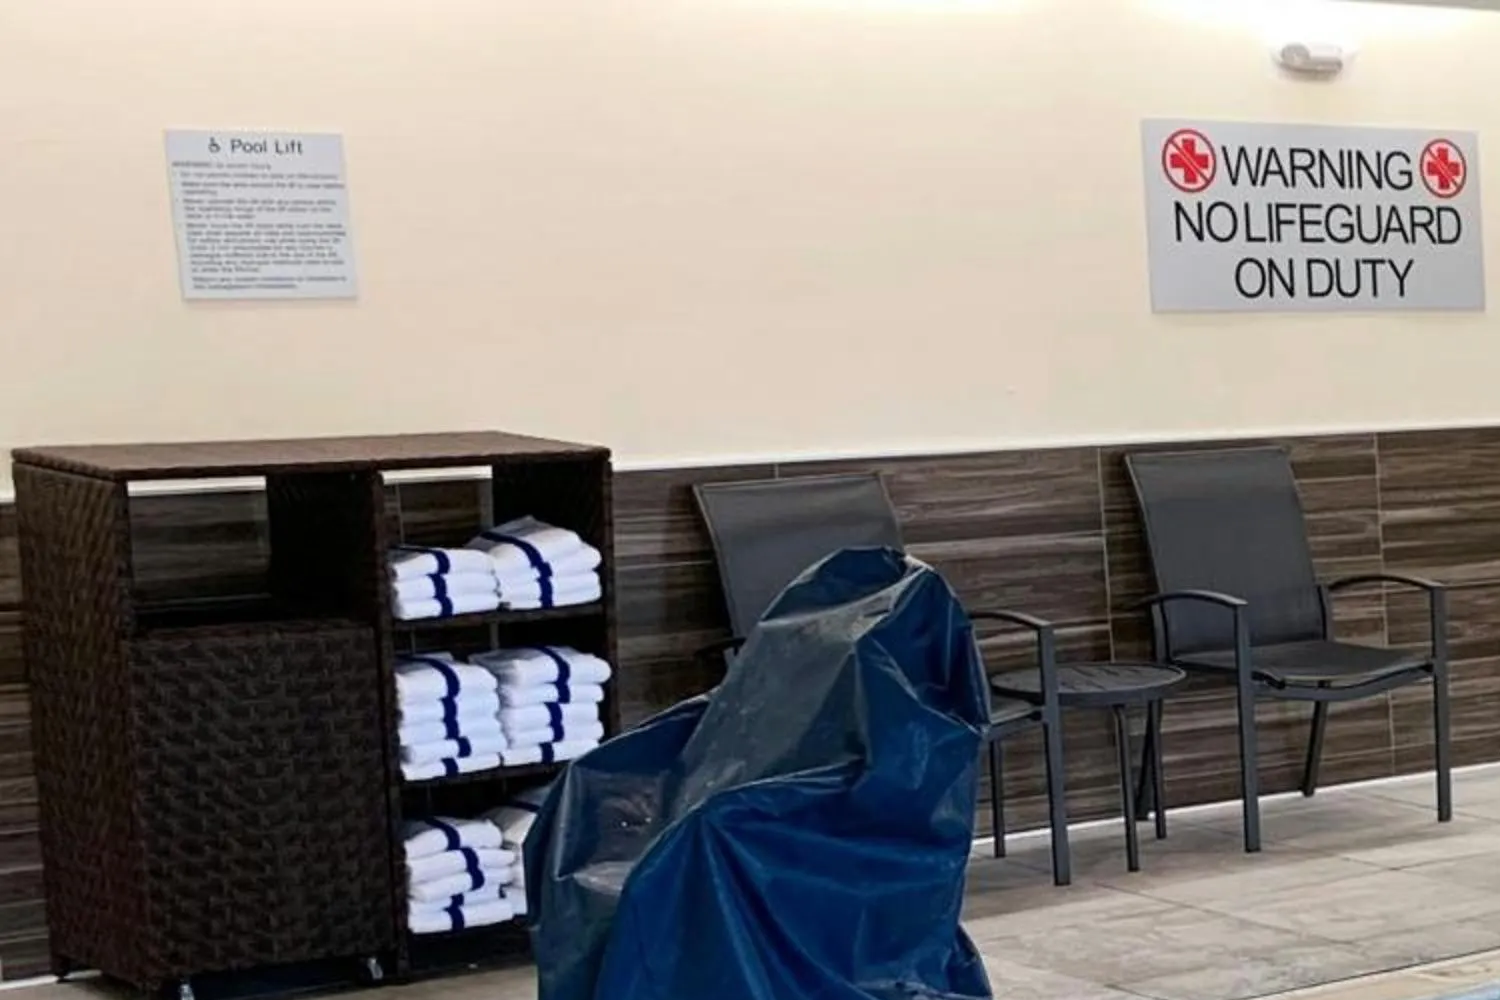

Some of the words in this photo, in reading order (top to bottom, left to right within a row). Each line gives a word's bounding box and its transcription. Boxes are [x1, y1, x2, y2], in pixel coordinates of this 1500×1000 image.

[230, 138, 268, 154] Pool
[275, 139, 304, 155] Lift
[1221, 145, 1413, 191] WARNING
[1174, 201, 1238, 243] NO
[1245, 202, 1462, 246] LIFEGUARD
[1235, 257, 1295, 299] ON
[1306, 258, 1414, 299] DUTY
